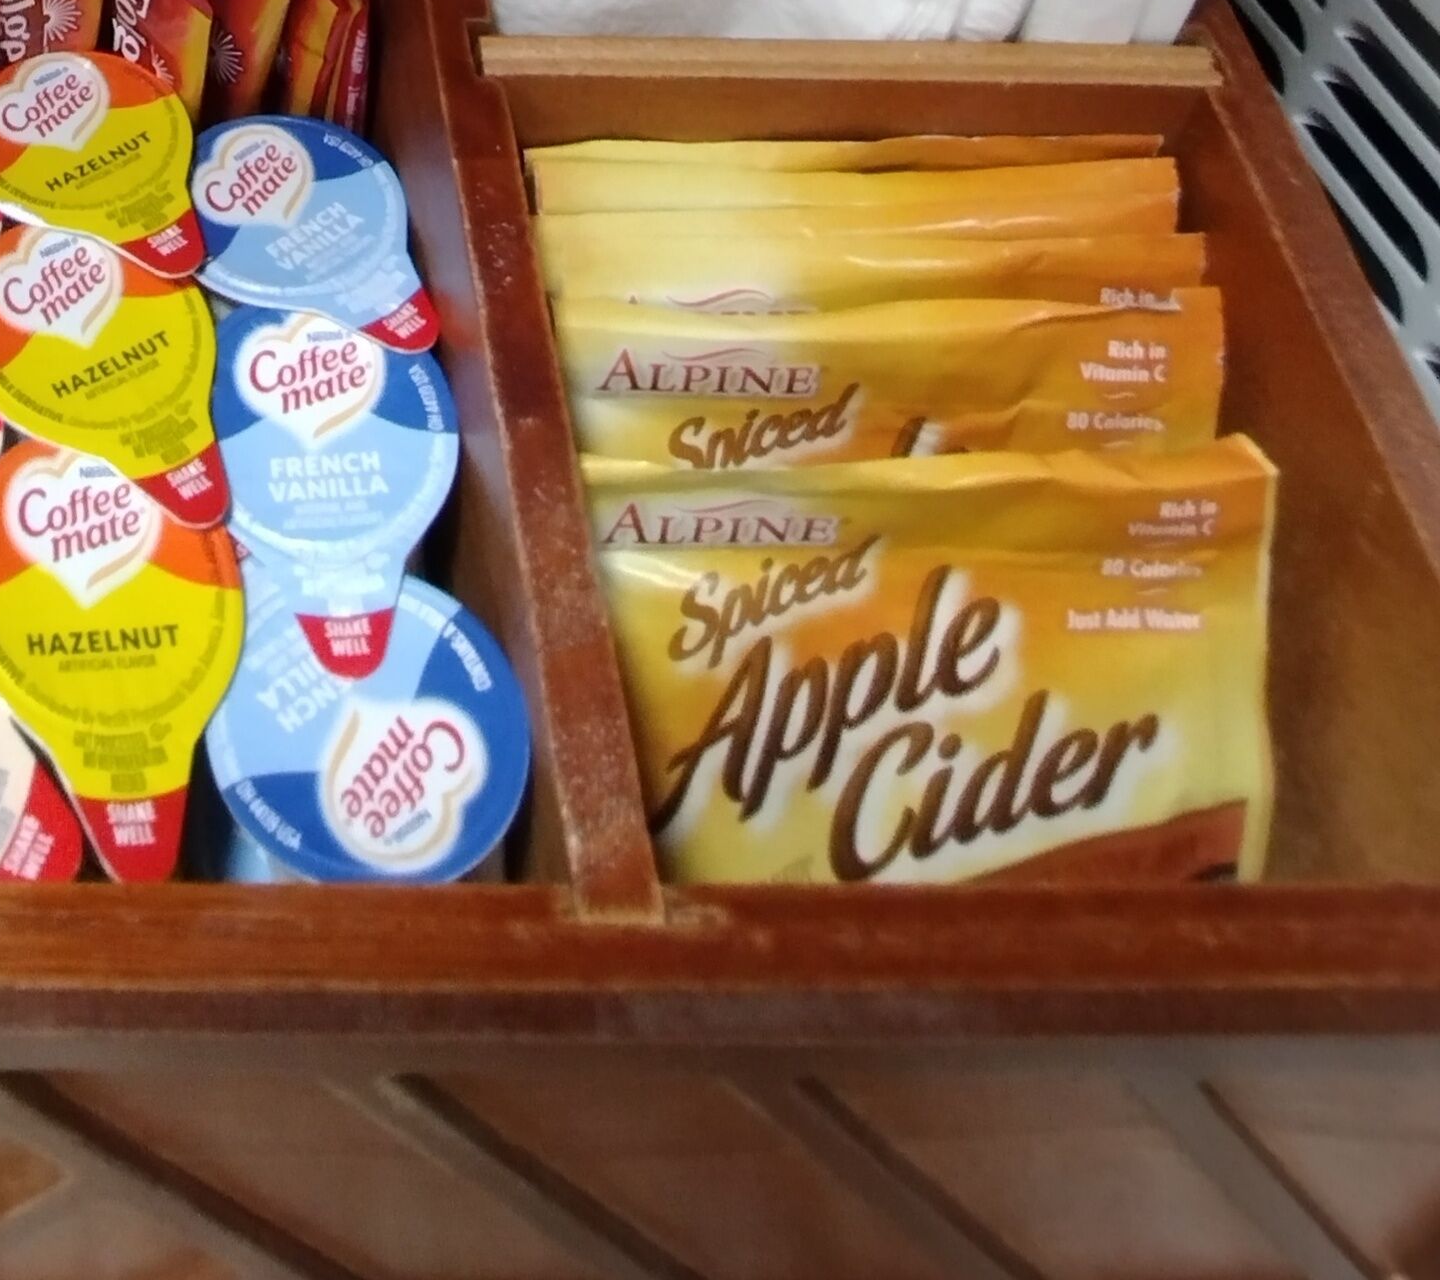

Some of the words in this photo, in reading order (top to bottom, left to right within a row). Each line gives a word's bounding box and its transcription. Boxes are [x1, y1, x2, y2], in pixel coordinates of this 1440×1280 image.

[2, 71, 81, 132] Coffee
[34, 85, 94, 138] mate
[45, 130, 152, 192] HAZELNUT
[205, 143, 282, 212] Coffee
[241, 155, 298, 216] mate
[264, 201, 348, 258] FRENCH
[276, 213, 365, 271] VANILLA
[3, 245, 91, 316] Coffee
[40, 261, 105, 326] mate
[51, 330, 171, 399] HAZELNUT
[250, 341, 358, 393] Coffee
[595, 348, 815, 395] ALPINE
[1080, 361, 1150, 383] Vitamin
[1153, 363, 1166, 383] C
[1108, 340, 1143, 359] Rich
[1148, 341, 1167, 359] in
[282, 365, 367, 414] mate
[668, 383, 860, 469] Spiced
[1093, 412, 1166, 431] Calories
[268, 473, 390, 503] VANILLA
[269, 451, 381, 479] FRENCH
[18, 482, 133, 538] Coffee
[51, 508, 141, 563] mate
[604, 502, 834, 545] ALPINE
[324, 617, 372, 638] SHAKE
[669, 535, 880, 668] Spiced
[1067, 609, 1101, 630] Just
[1106, 608, 1140, 630] Add
[26, 624, 179, 656] HAZELNUT
[328, 636, 371, 657] WELL
[654, 565, 1002, 836] Apple
[339, 714, 416, 819] mate
[363, 719, 466, 839] Coffee
[830, 689, 1160, 883] Cider
